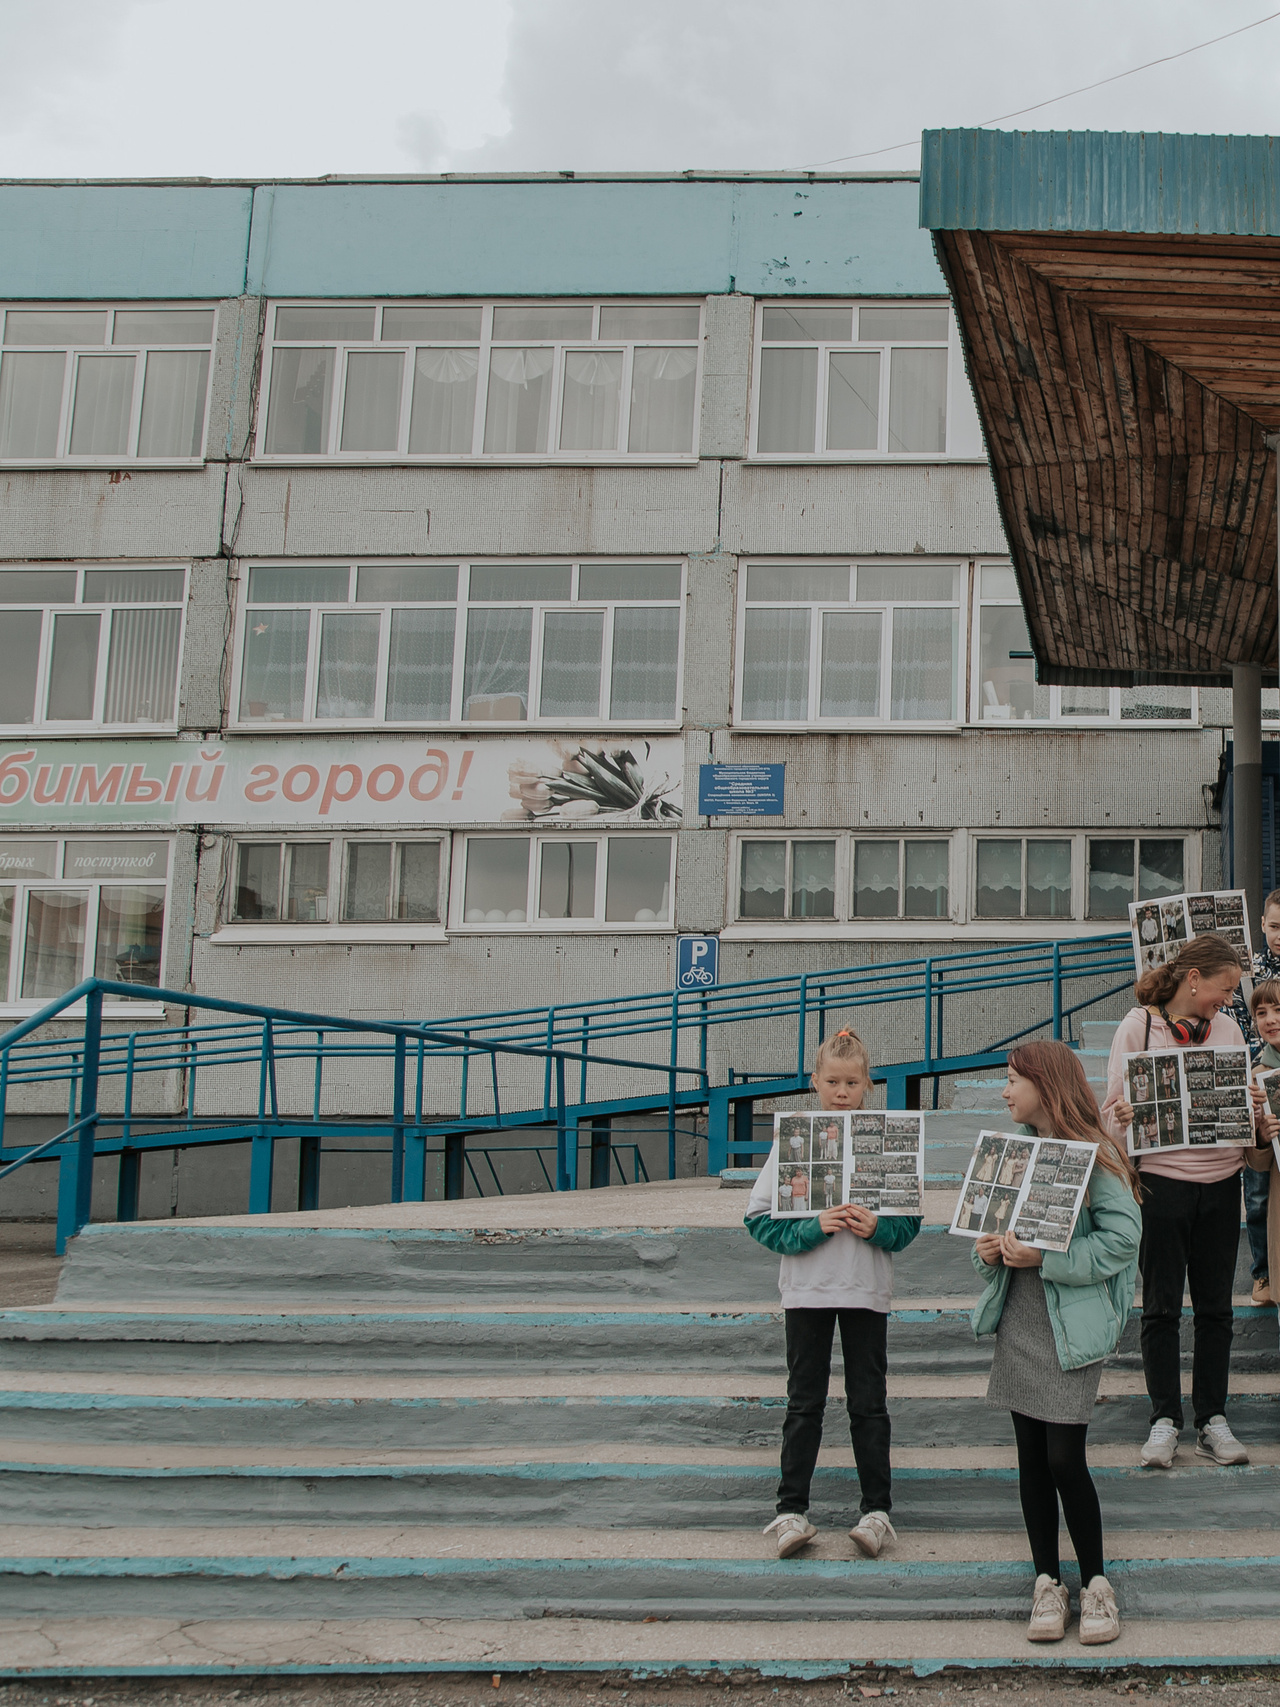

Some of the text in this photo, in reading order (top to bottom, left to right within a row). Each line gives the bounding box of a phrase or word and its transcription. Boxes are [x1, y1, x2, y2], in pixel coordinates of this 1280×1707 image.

[244, 748, 475, 815] город!
[73, 852, 157, 870] поступков
[691, 940, 709, 965] P
